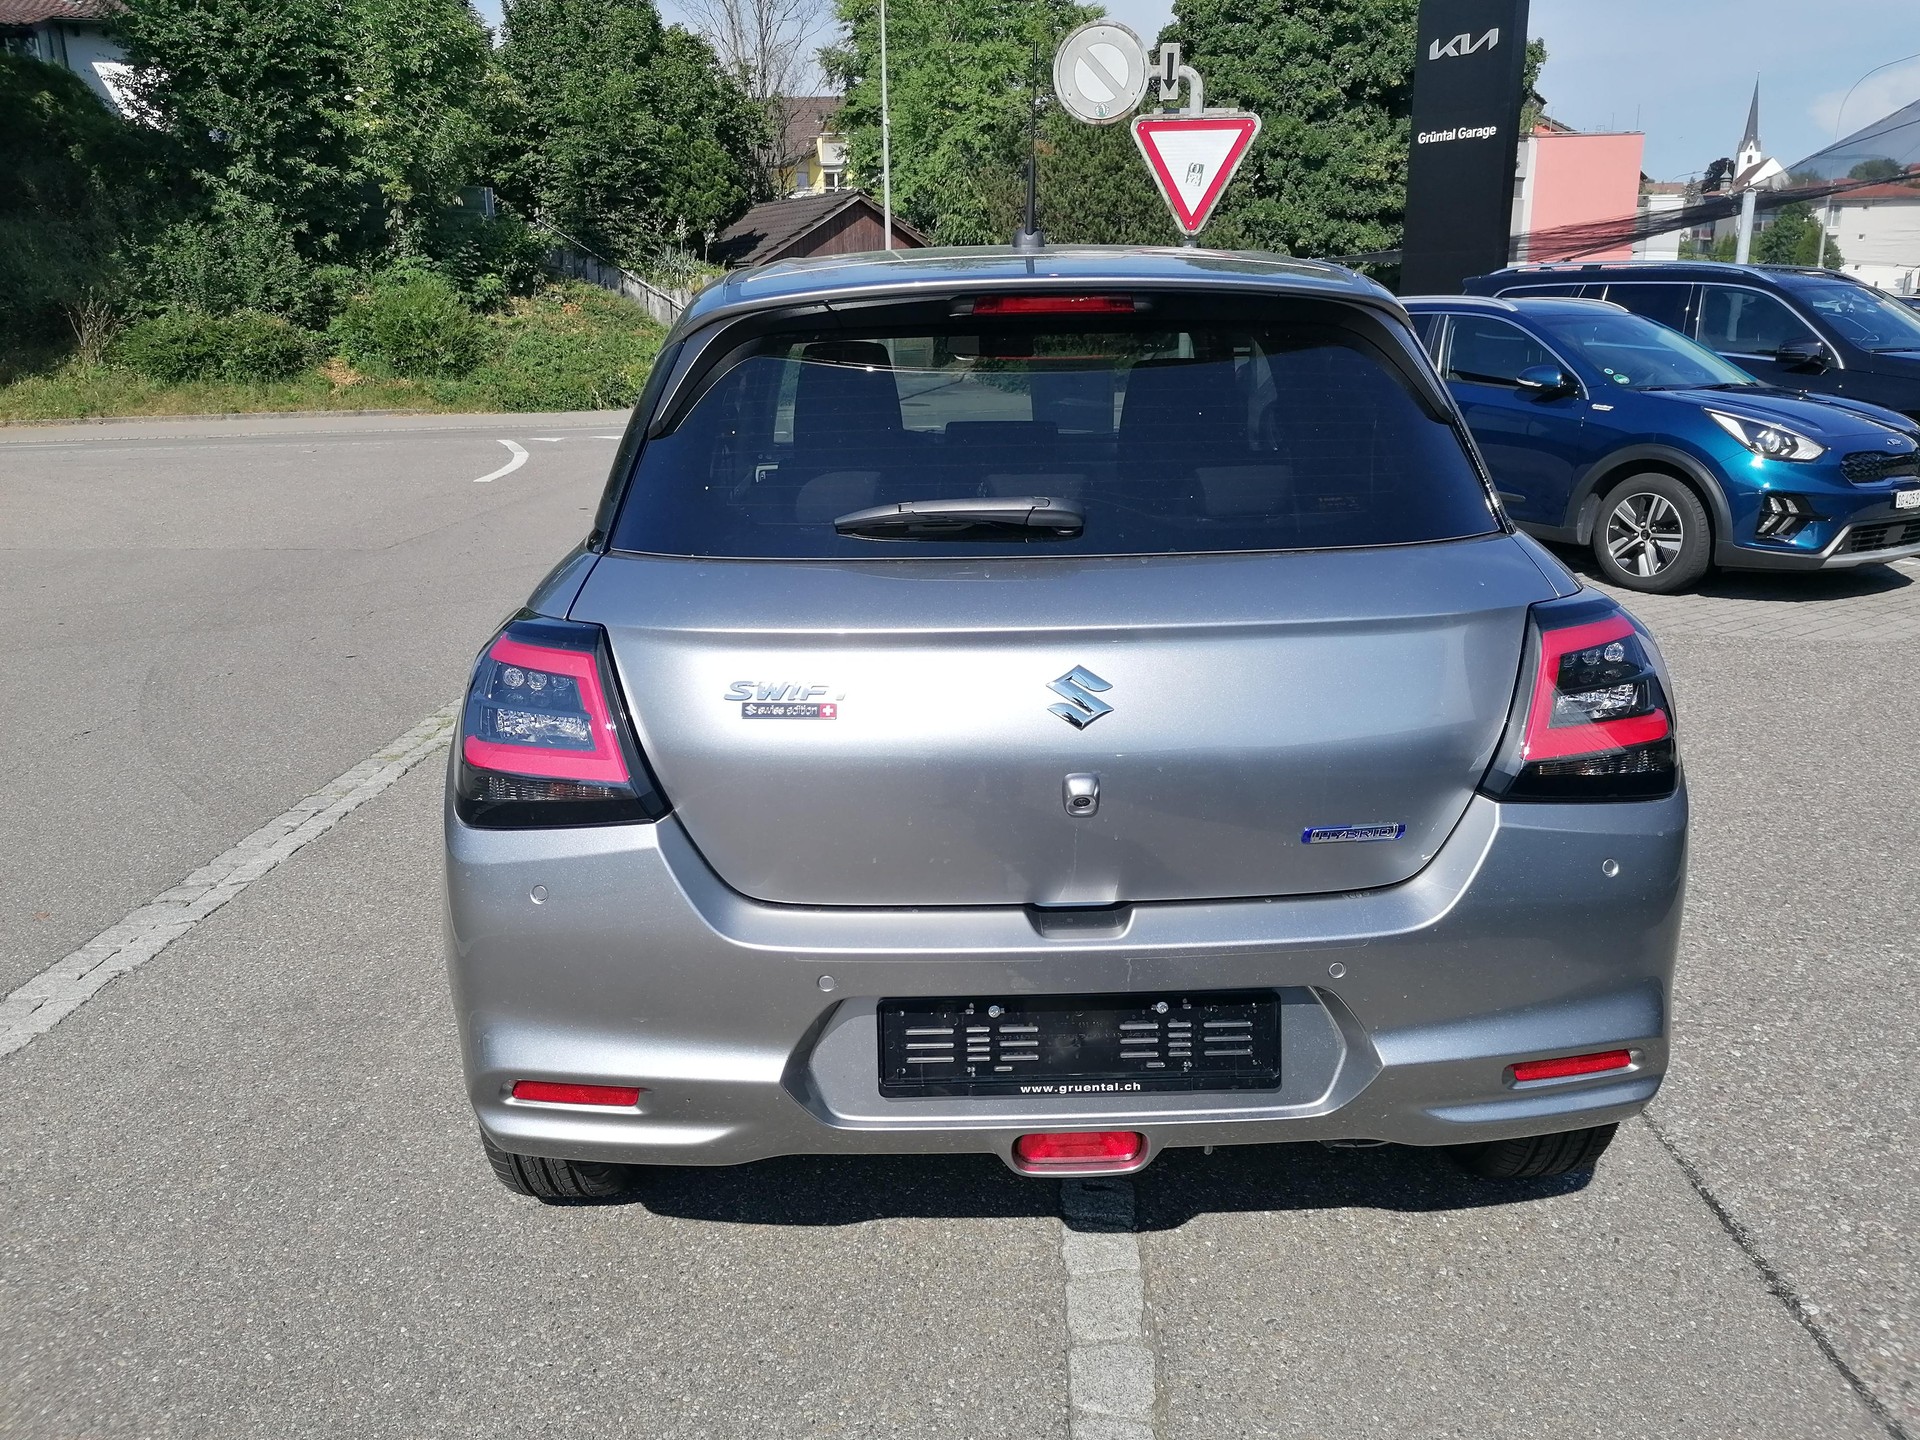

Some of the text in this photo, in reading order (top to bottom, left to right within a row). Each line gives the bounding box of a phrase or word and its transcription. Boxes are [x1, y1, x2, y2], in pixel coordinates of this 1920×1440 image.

[1417, 126, 1497, 144] Grüntal Garage
[724, 680, 846, 701] SWIF
[1020, 1082, 1141, 1094] www.gruental.ch
